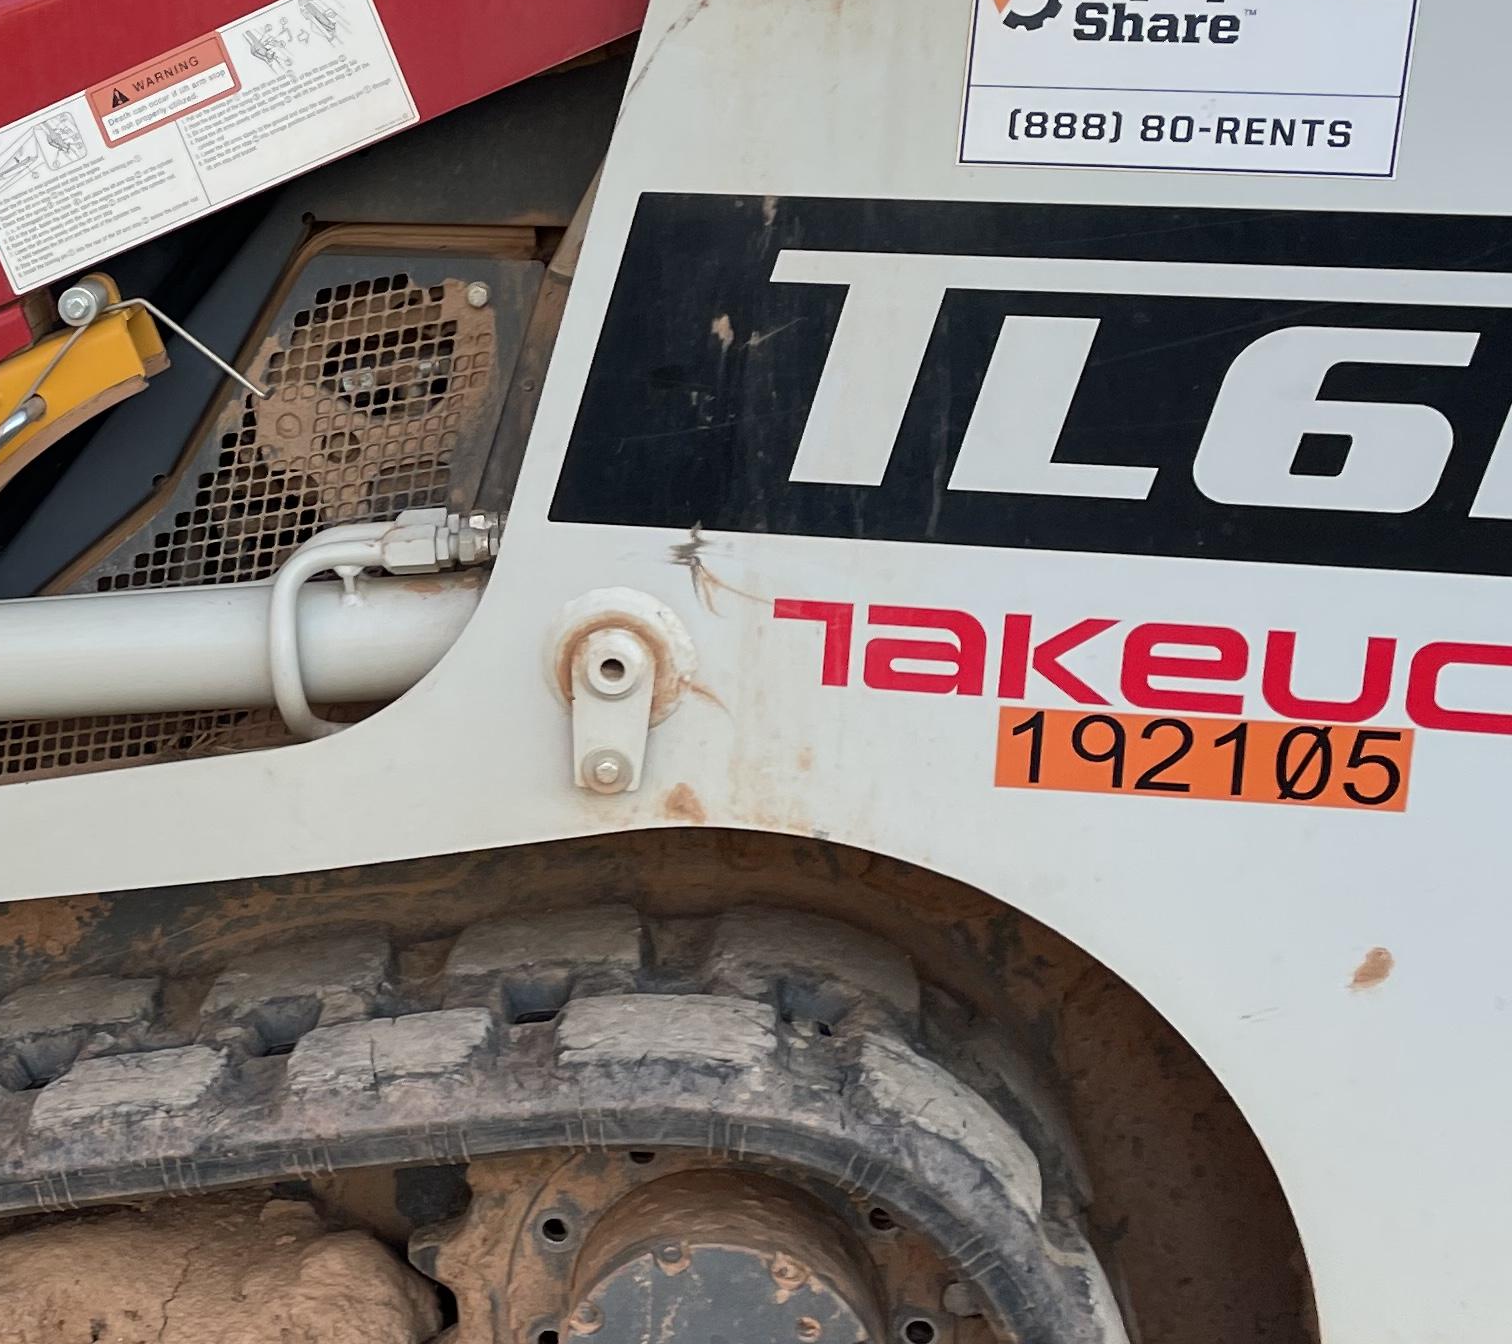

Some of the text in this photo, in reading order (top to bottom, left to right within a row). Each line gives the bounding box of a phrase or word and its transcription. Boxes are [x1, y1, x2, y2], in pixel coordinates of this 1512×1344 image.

[1073, 2, 1240, 44] Share
[132, 56, 199, 91] WARNING
[1008, 108, 1353, 148] (888) 80-RENTS
[769, 249, 1512, 520] TL6
[1011, 710, 1402, 806] 192105
